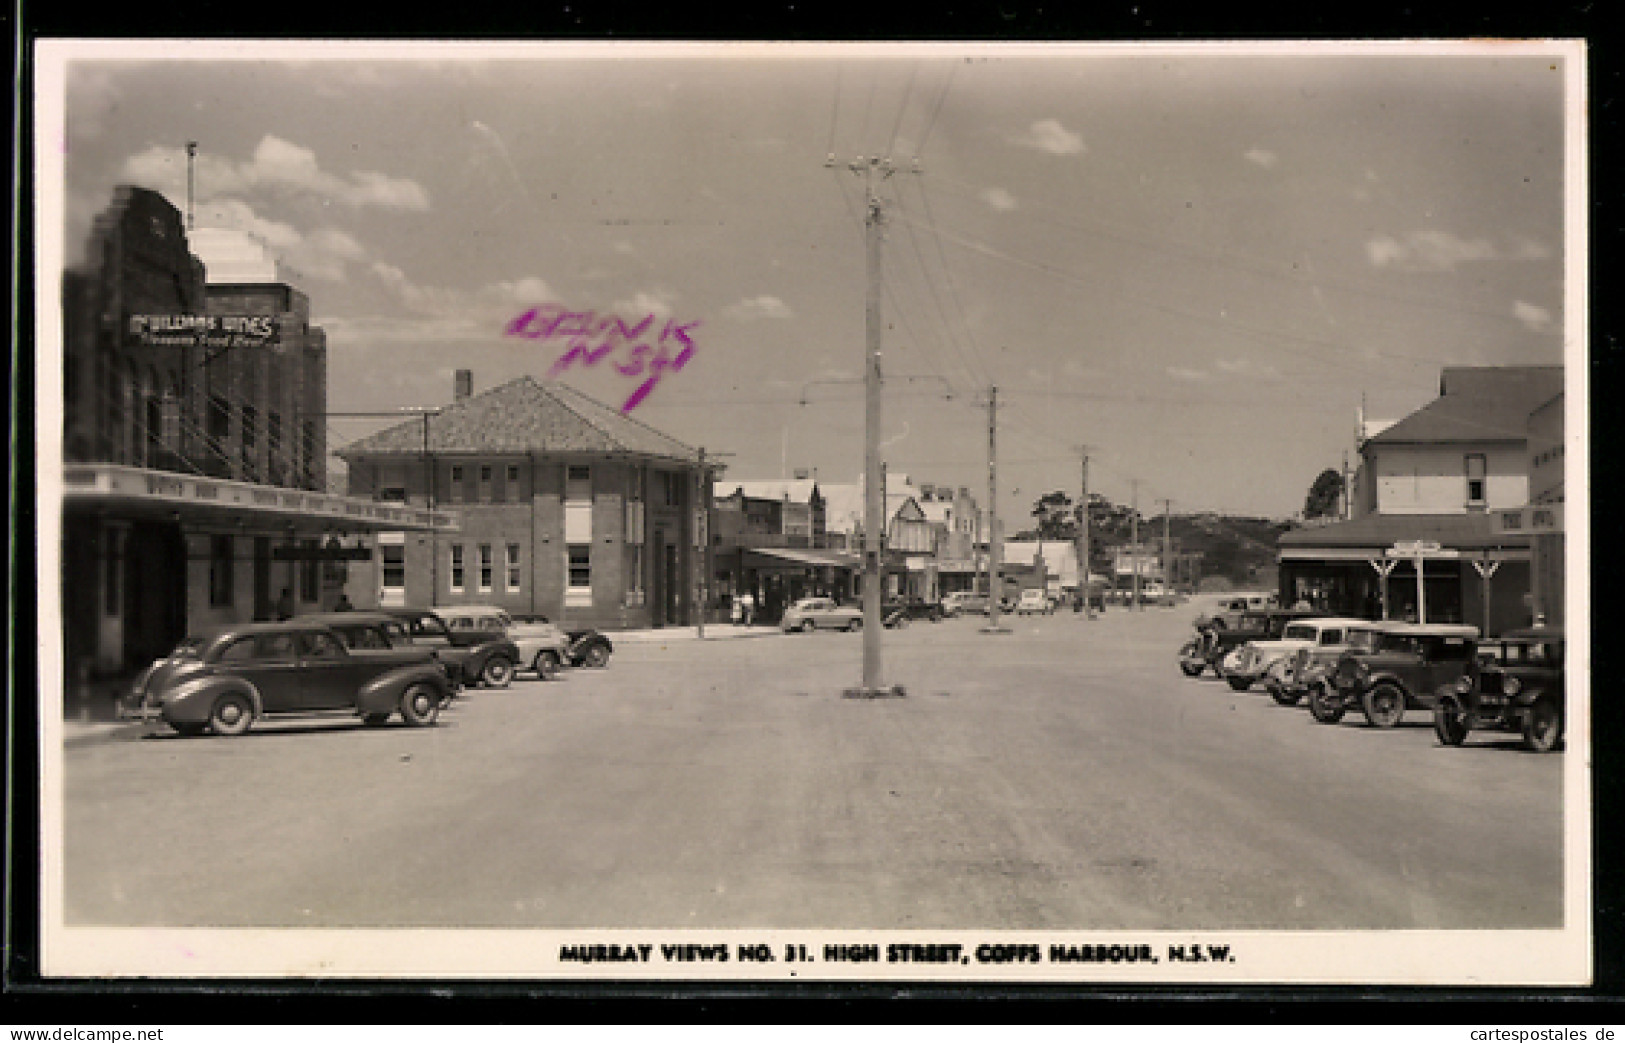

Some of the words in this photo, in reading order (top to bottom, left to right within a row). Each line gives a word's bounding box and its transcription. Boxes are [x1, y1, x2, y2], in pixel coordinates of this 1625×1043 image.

[559, 943, 652, 963] MURRAY
[660, 943, 730, 963] VIEWS
[738, 943, 775, 963] NO.
[784, 943, 814, 963] 31.
[822, 943, 879, 963] HIGH
[885, 943, 970, 965] STREET,
[974, 943, 1042, 964] COFFS
[1049, 943, 1159, 965] HARBOUR,
[1168, 943, 1236, 963] N.S.W.
